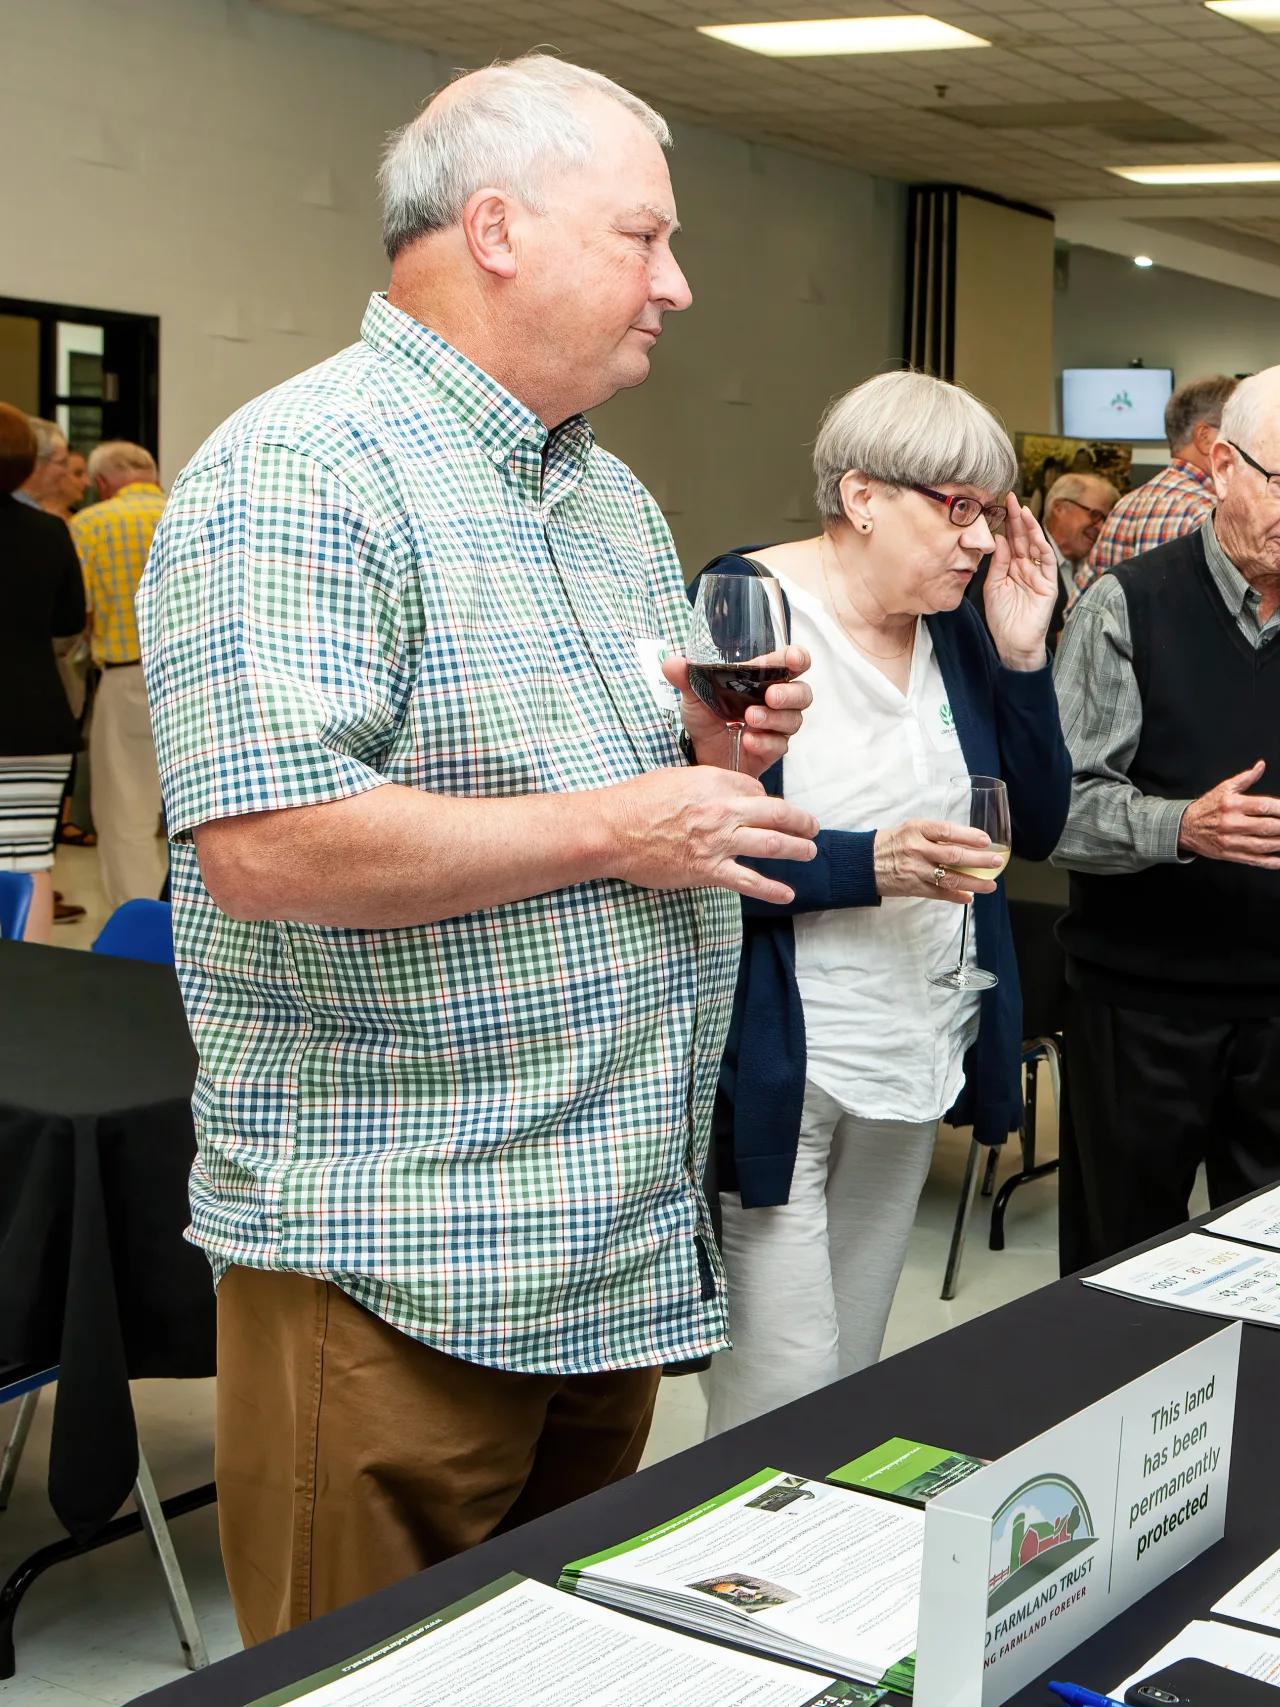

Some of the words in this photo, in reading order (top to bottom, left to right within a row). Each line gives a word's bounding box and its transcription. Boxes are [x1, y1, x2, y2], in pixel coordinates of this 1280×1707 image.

[1145, 1274, 1187, 1291] 1,000+
[1151, 1400, 1180, 1435] This
[1184, 1375, 1215, 1414] land
[1143, 1446, 1168, 1478] has
[1172, 1421, 1207, 1458] been
[1129, 1446, 1221, 1530] permanently
[1136, 1484, 1209, 1561] protected
[994, 1583, 1058, 1641] FARMLAND
[1060, 1556, 1095, 1592] TRUST
[999, 1616, 1047, 1658] FARMLAND
[1049, 1586, 1087, 1621] FOREVER
[339, 1618, 444, 1672] www.ontariofarmlandtrust.ca
